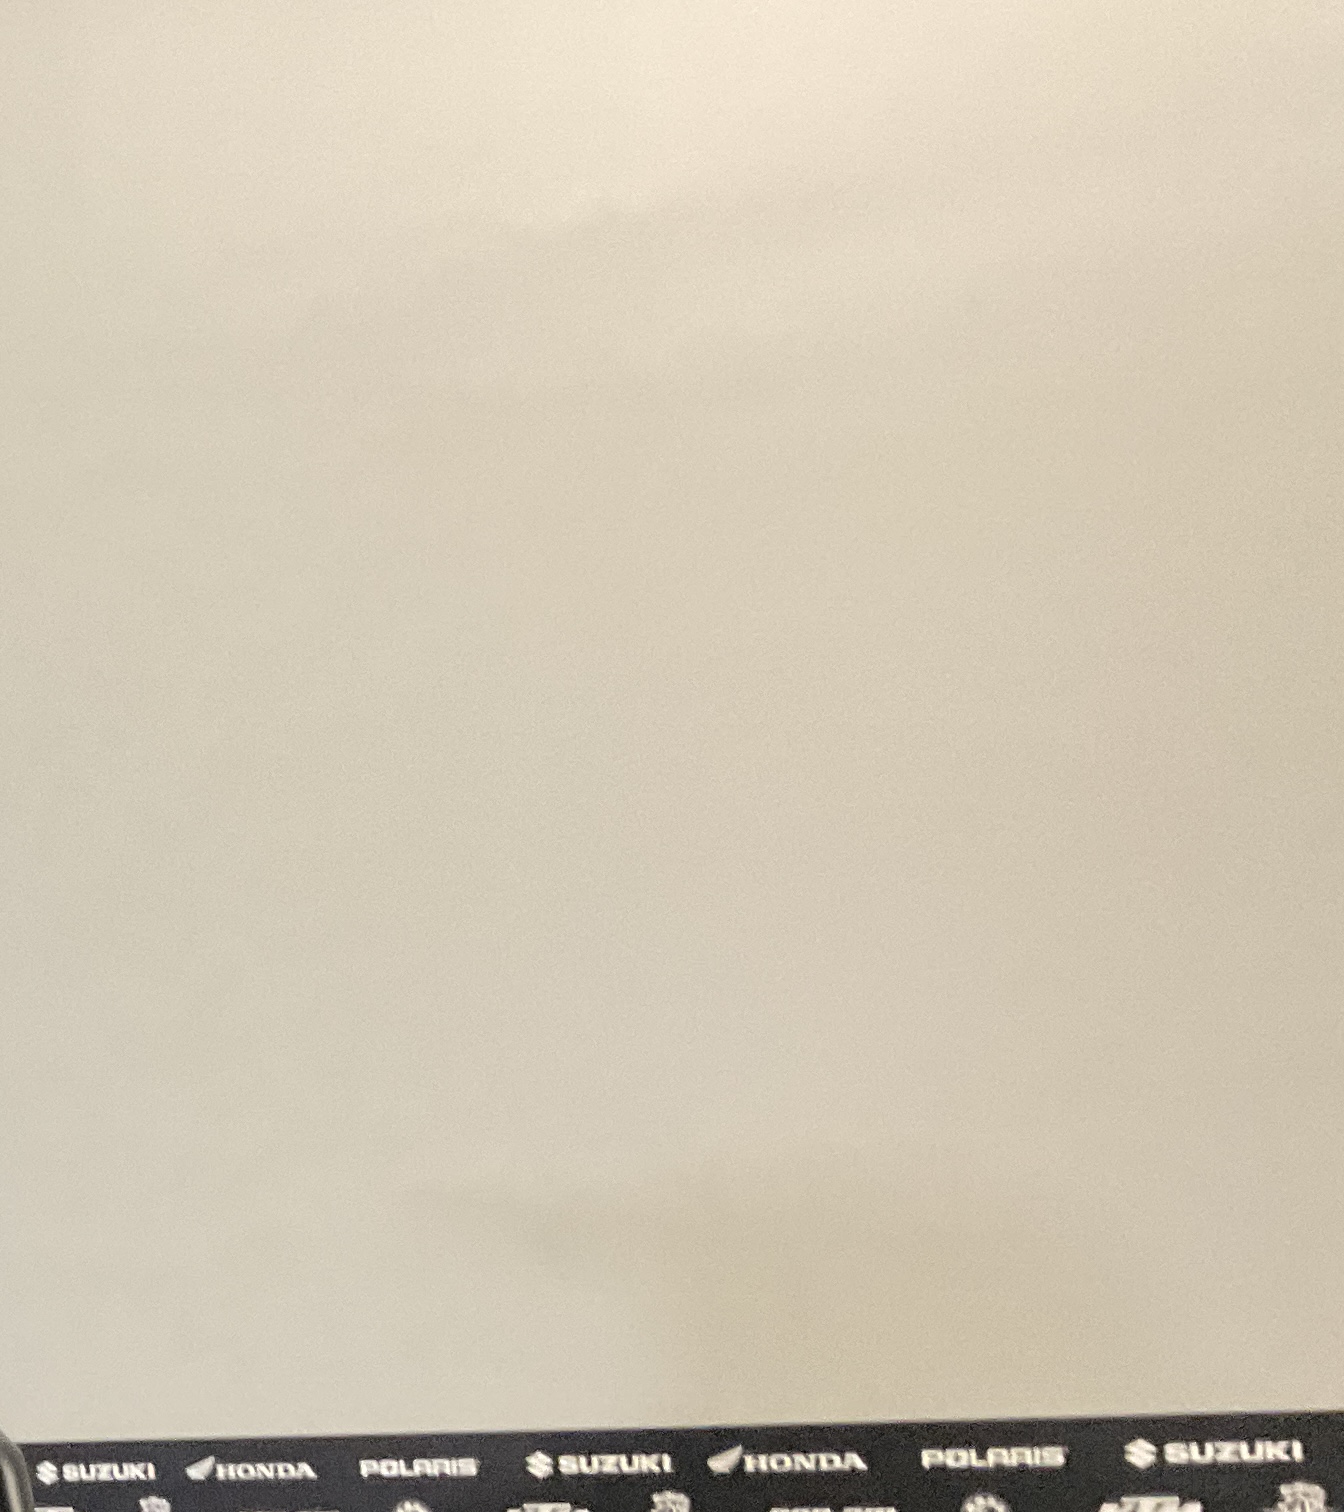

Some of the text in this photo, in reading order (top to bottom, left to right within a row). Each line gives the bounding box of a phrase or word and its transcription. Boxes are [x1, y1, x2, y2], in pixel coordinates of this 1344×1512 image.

[921, 1447, 1065, 1469] POLARIS
[1164, 1440, 1303, 1464] SUZUKI
[63, 1463, 155, 1481] SUZUKI
[216, 1462, 317, 1480] HONDA
[360, 1458, 478, 1477] POLARIS
[559, 1454, 672, 1474] SUZUKI
[743, 1453, 867, 1472] HONDA
